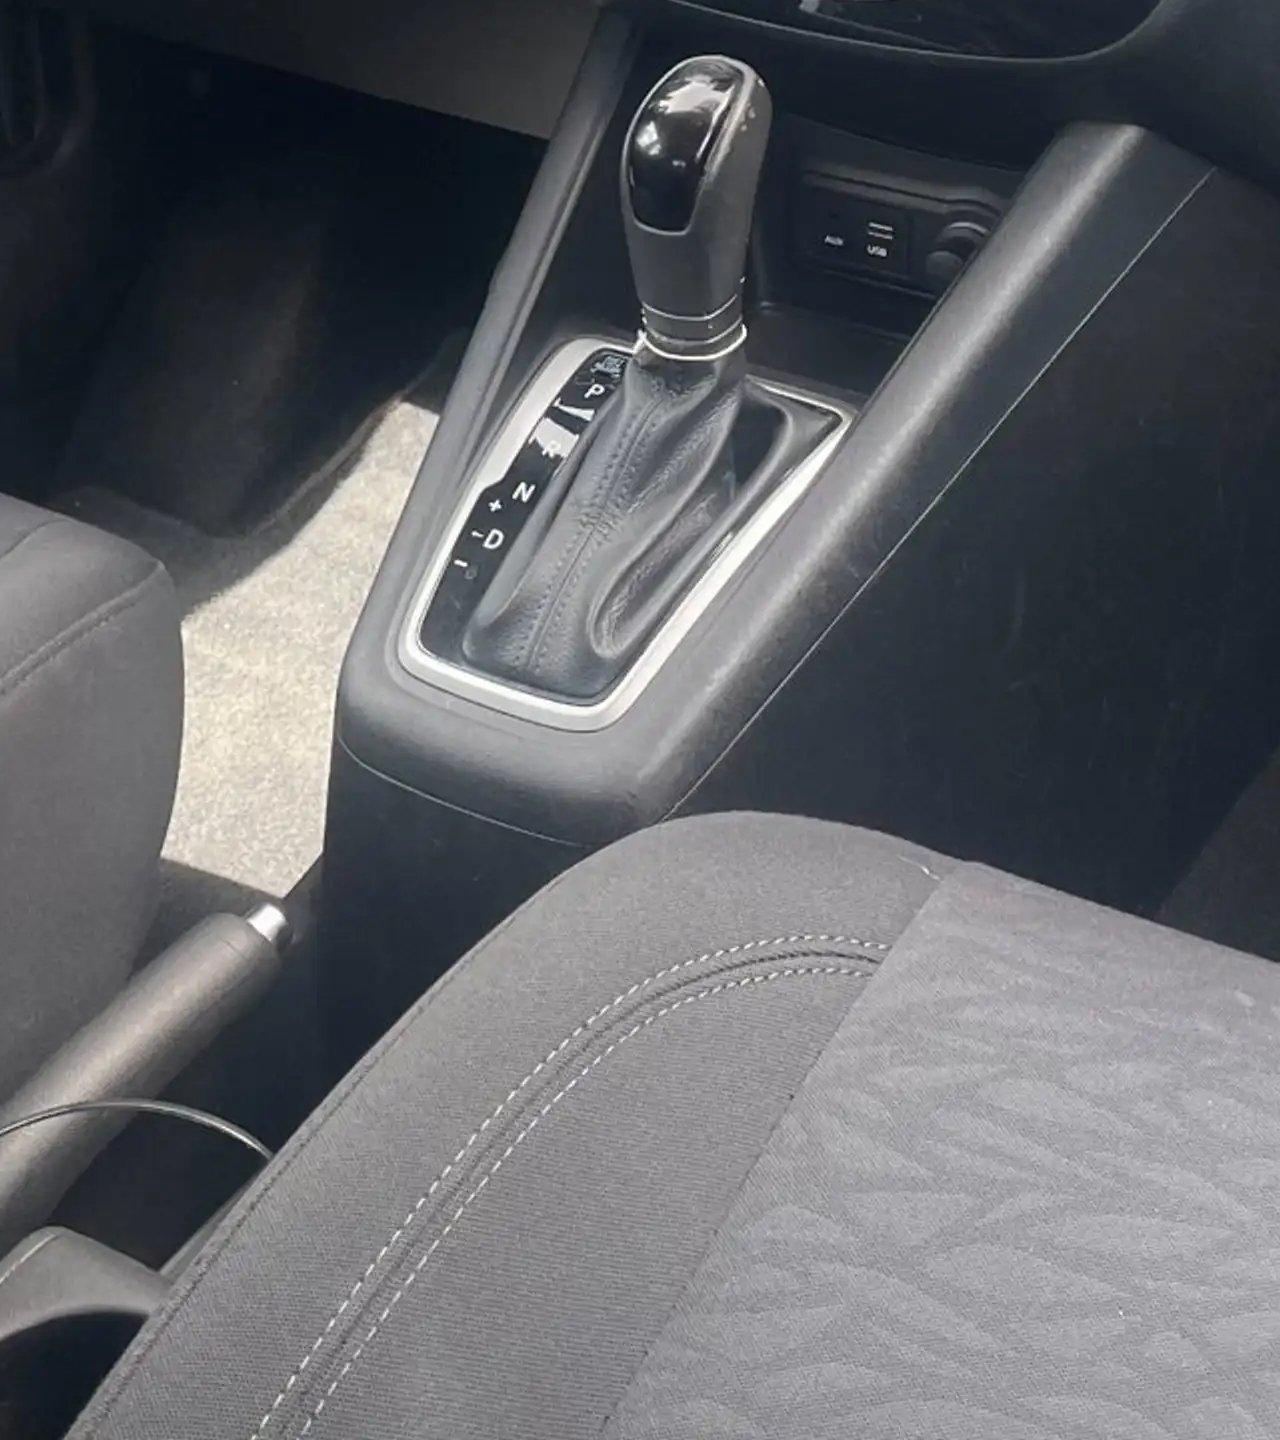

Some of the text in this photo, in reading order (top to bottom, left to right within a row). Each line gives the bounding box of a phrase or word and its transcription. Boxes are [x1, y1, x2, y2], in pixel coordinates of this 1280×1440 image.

[866, 244, 888, 258] USB
[583, 383, 605, 399] P
[542, 439, 562, 459] R
[511, 481, 536, 504] N
[482, 527, 505, 550] D
